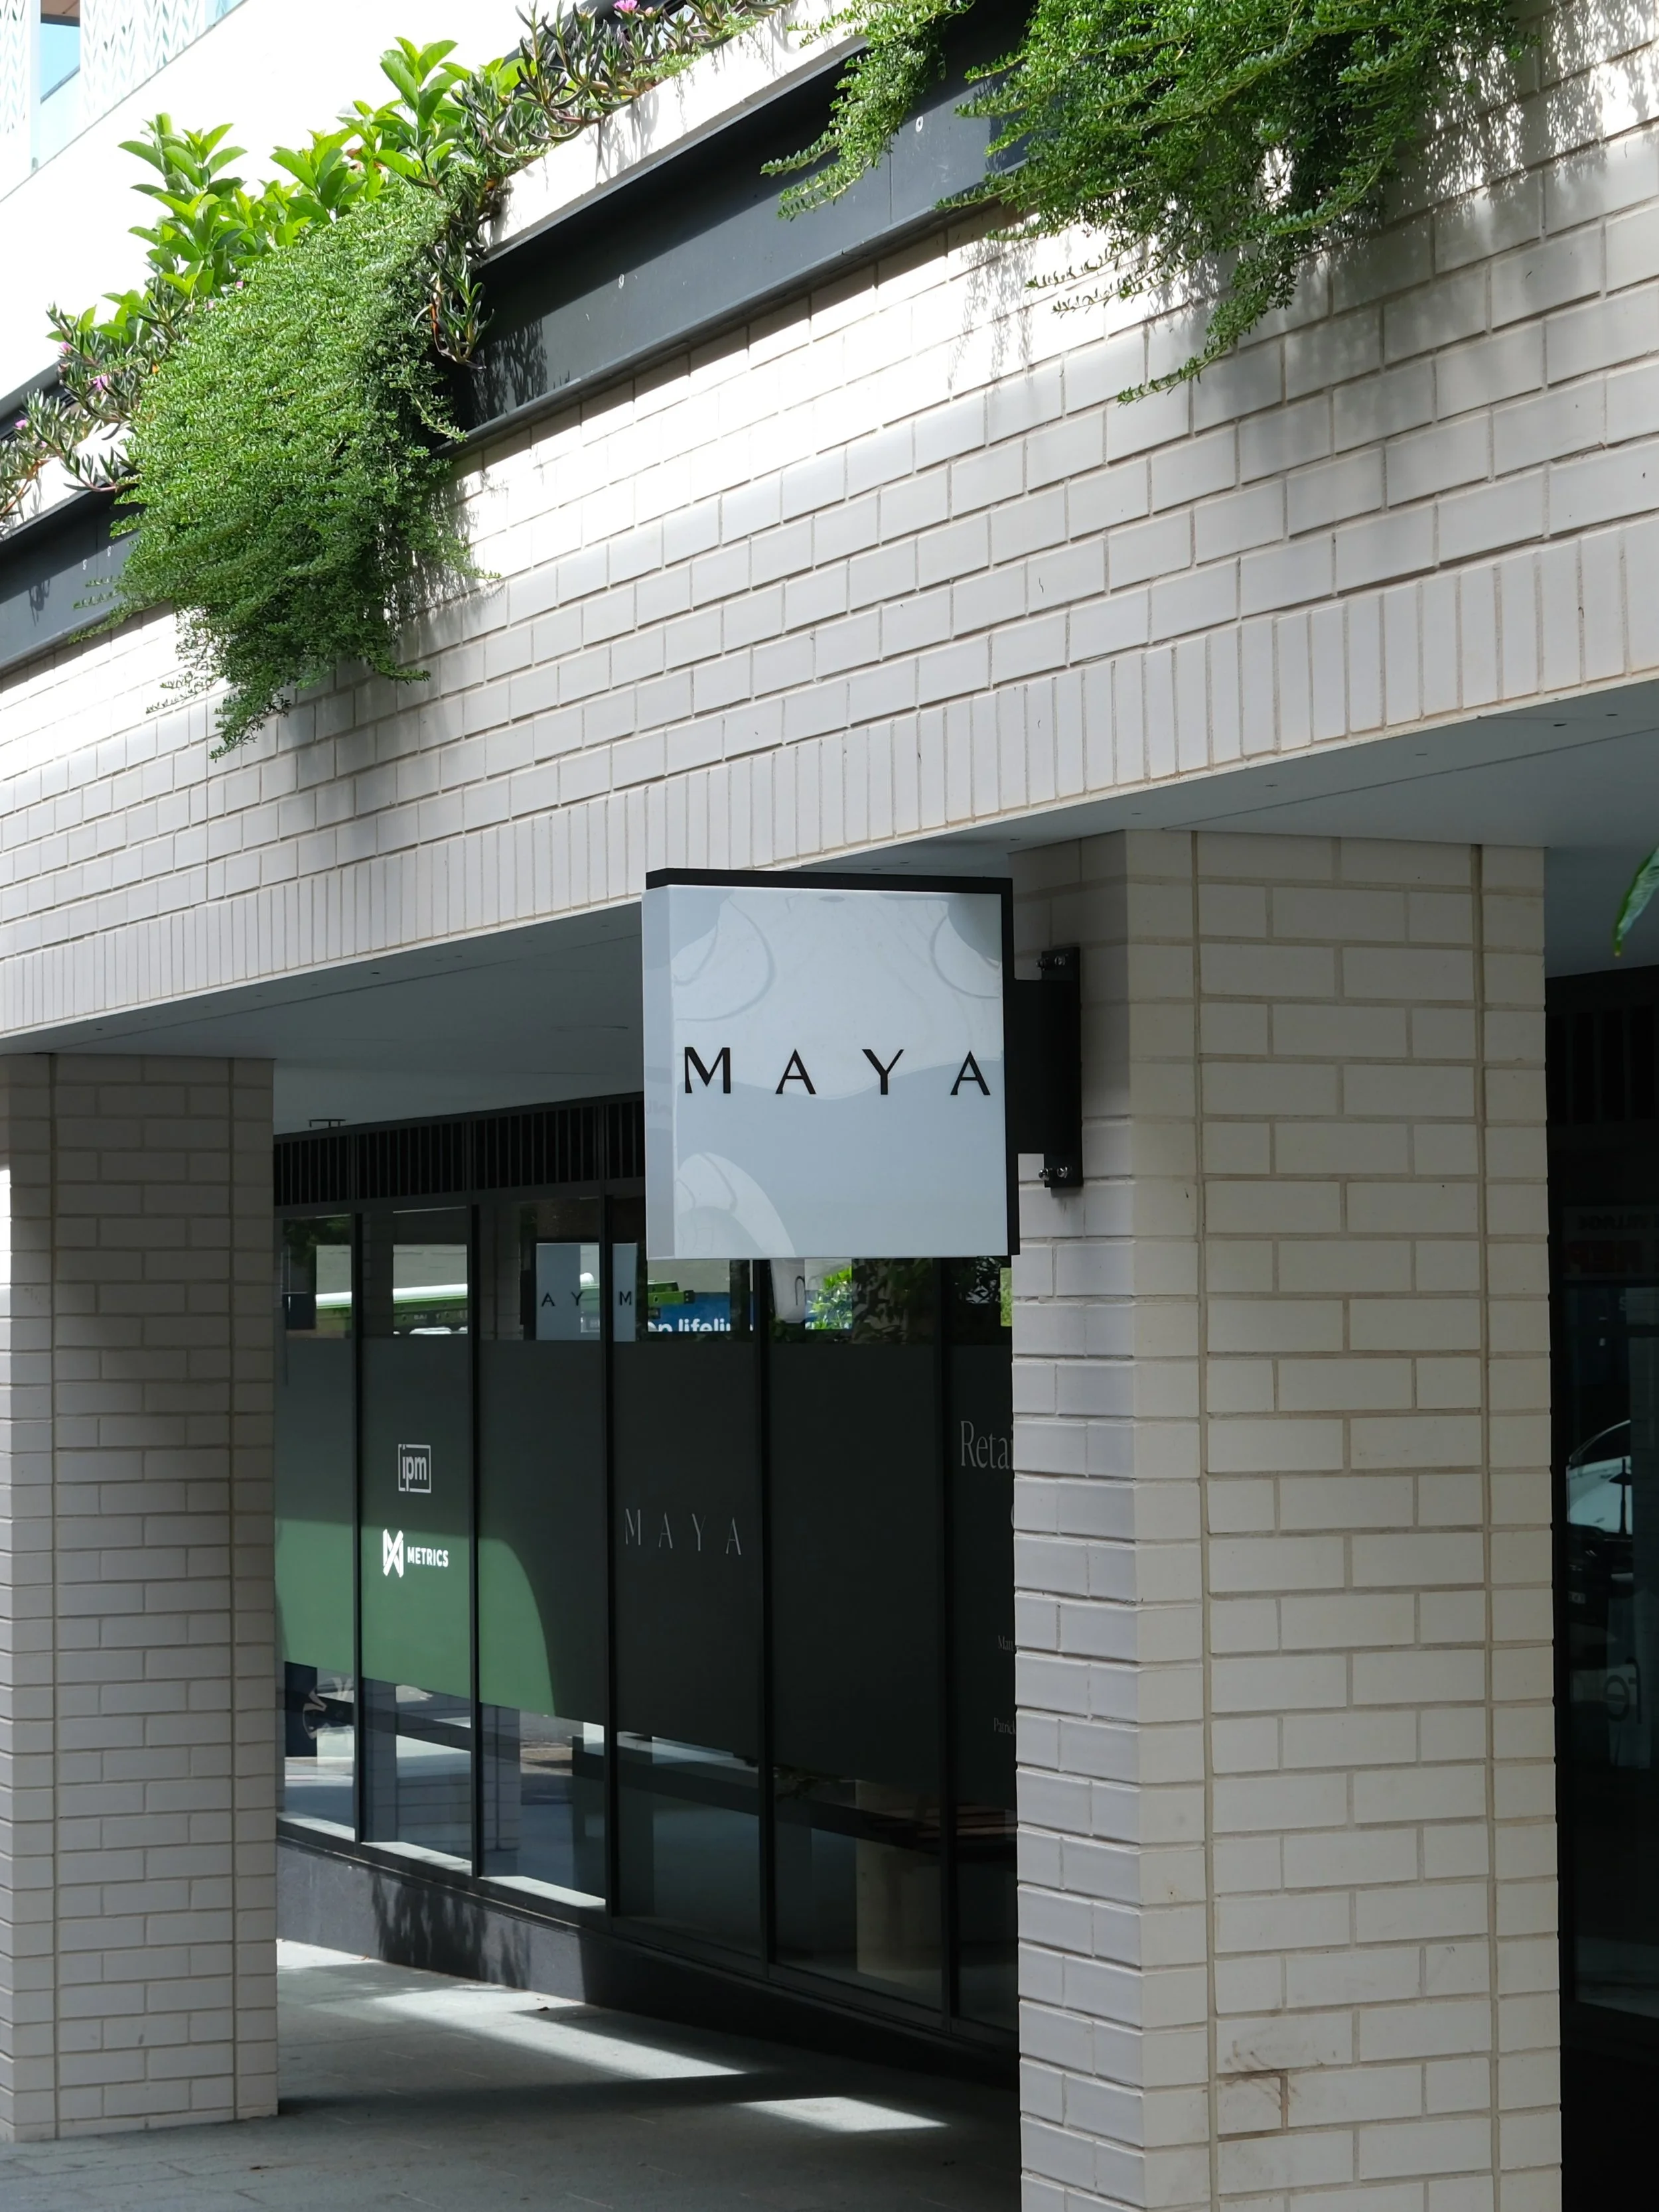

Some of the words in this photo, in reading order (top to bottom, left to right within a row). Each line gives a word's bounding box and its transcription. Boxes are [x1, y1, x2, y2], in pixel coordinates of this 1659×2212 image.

[684, 1046, 991, 1095] MAYA
[401, 1444, 428, 1491] ipm
[625, 1508, 742, 1555] MAYA
[407, 1547, 449, 1567] METRICS
